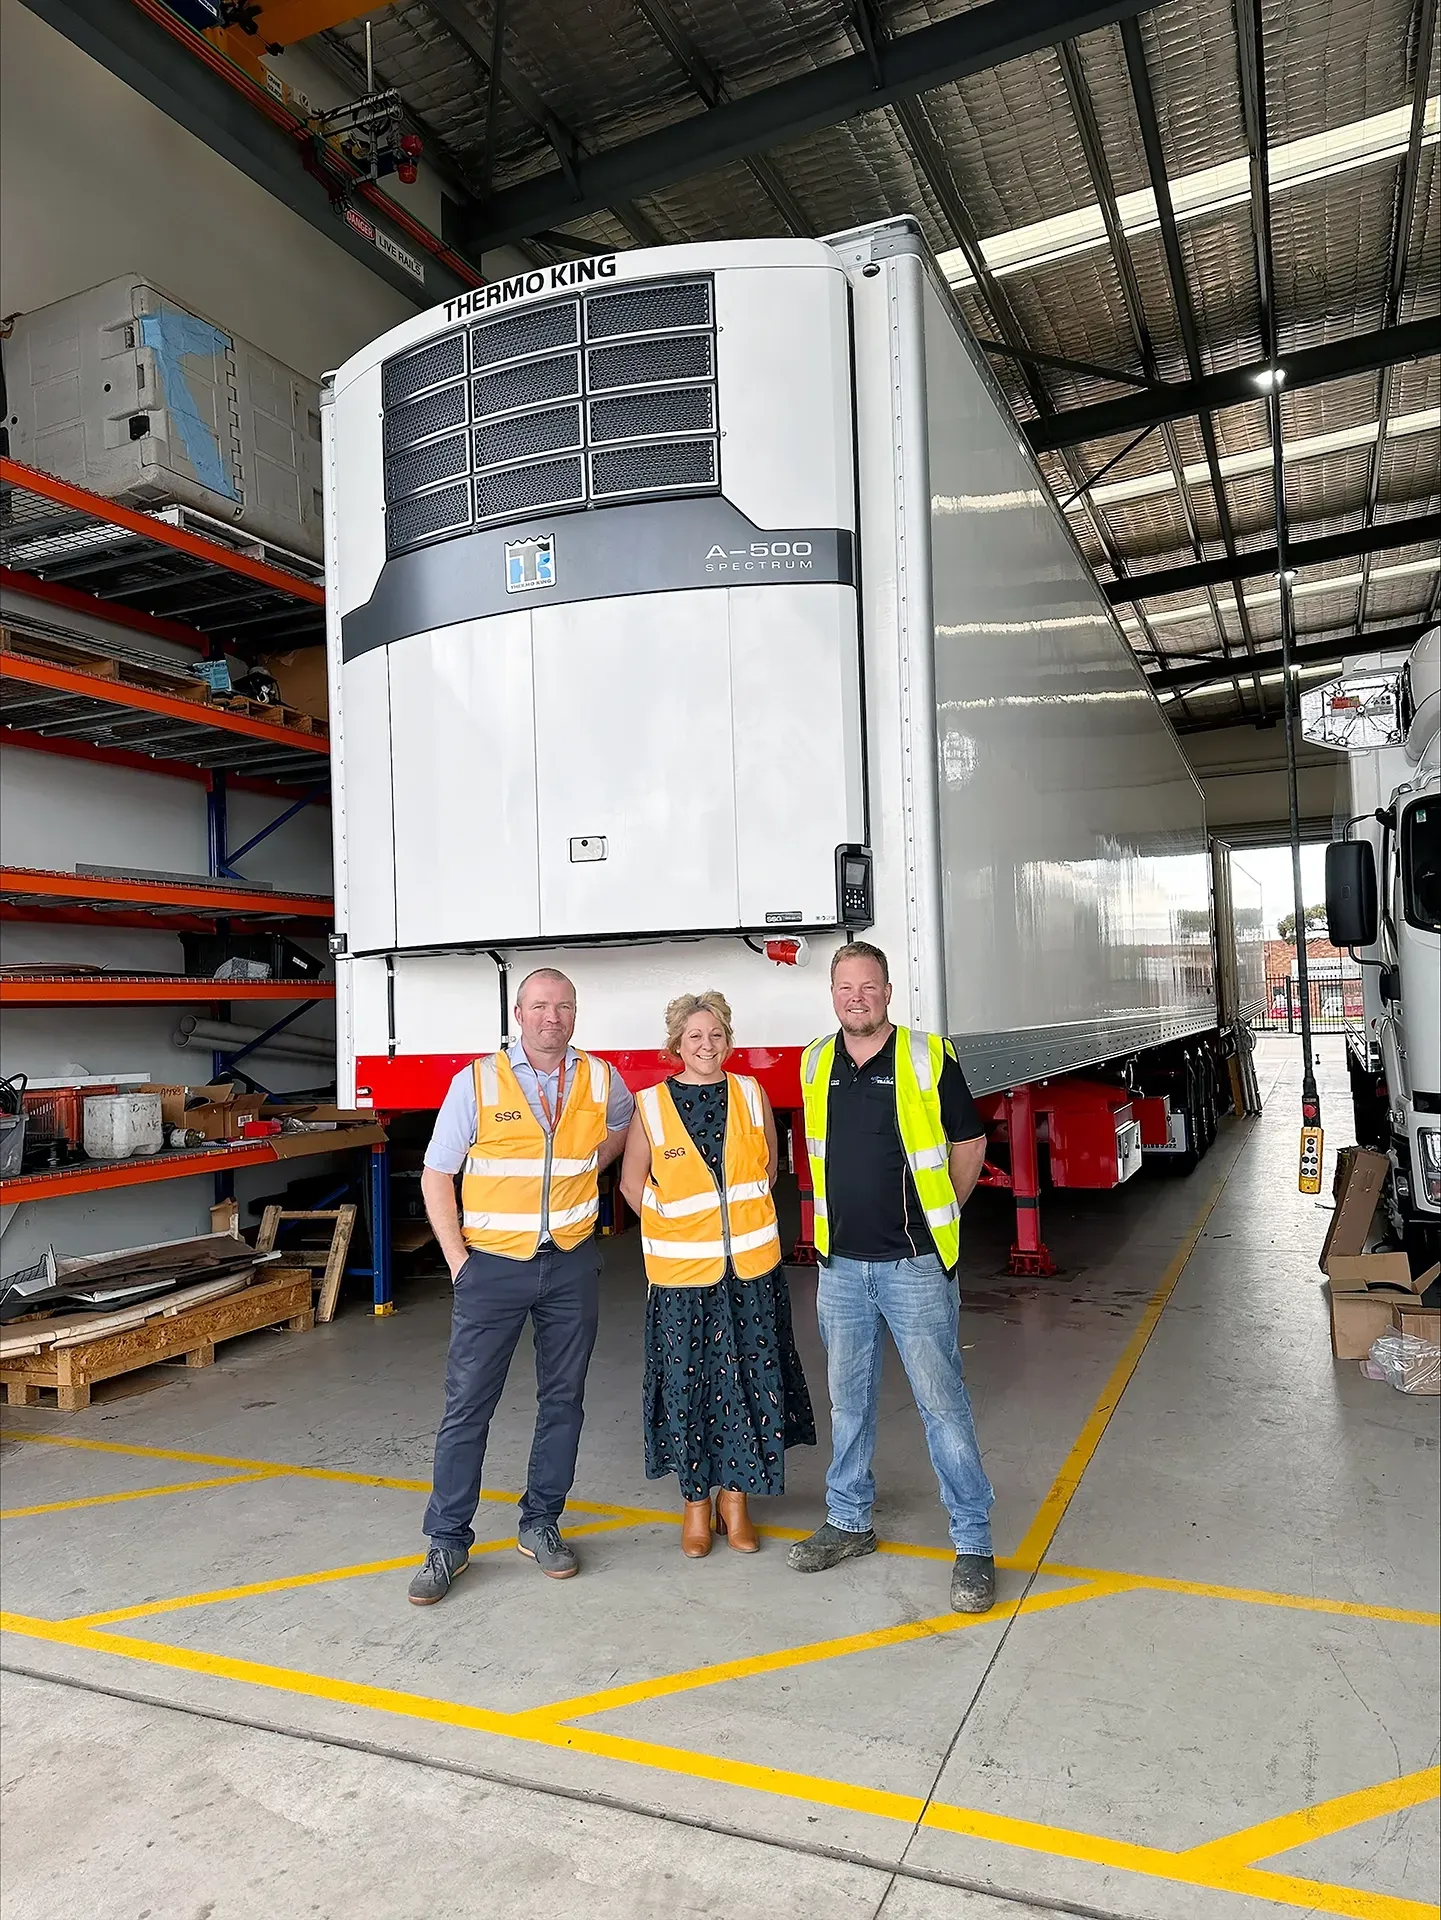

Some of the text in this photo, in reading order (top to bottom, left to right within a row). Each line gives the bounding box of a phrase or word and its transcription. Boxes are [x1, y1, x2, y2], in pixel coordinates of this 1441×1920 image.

[346, 210, 374, 238] DANGER
[379, 235, 422, 276] LIVE RAILS
[443, 255, 616, 323] THERMO KING
[704, 541, 813, 560] A-500
[705, 560, 813, 572] SPECTRUM
[494, 1110, 522, 1123] SSG
[663, 1147, 686, 1160] SSG
